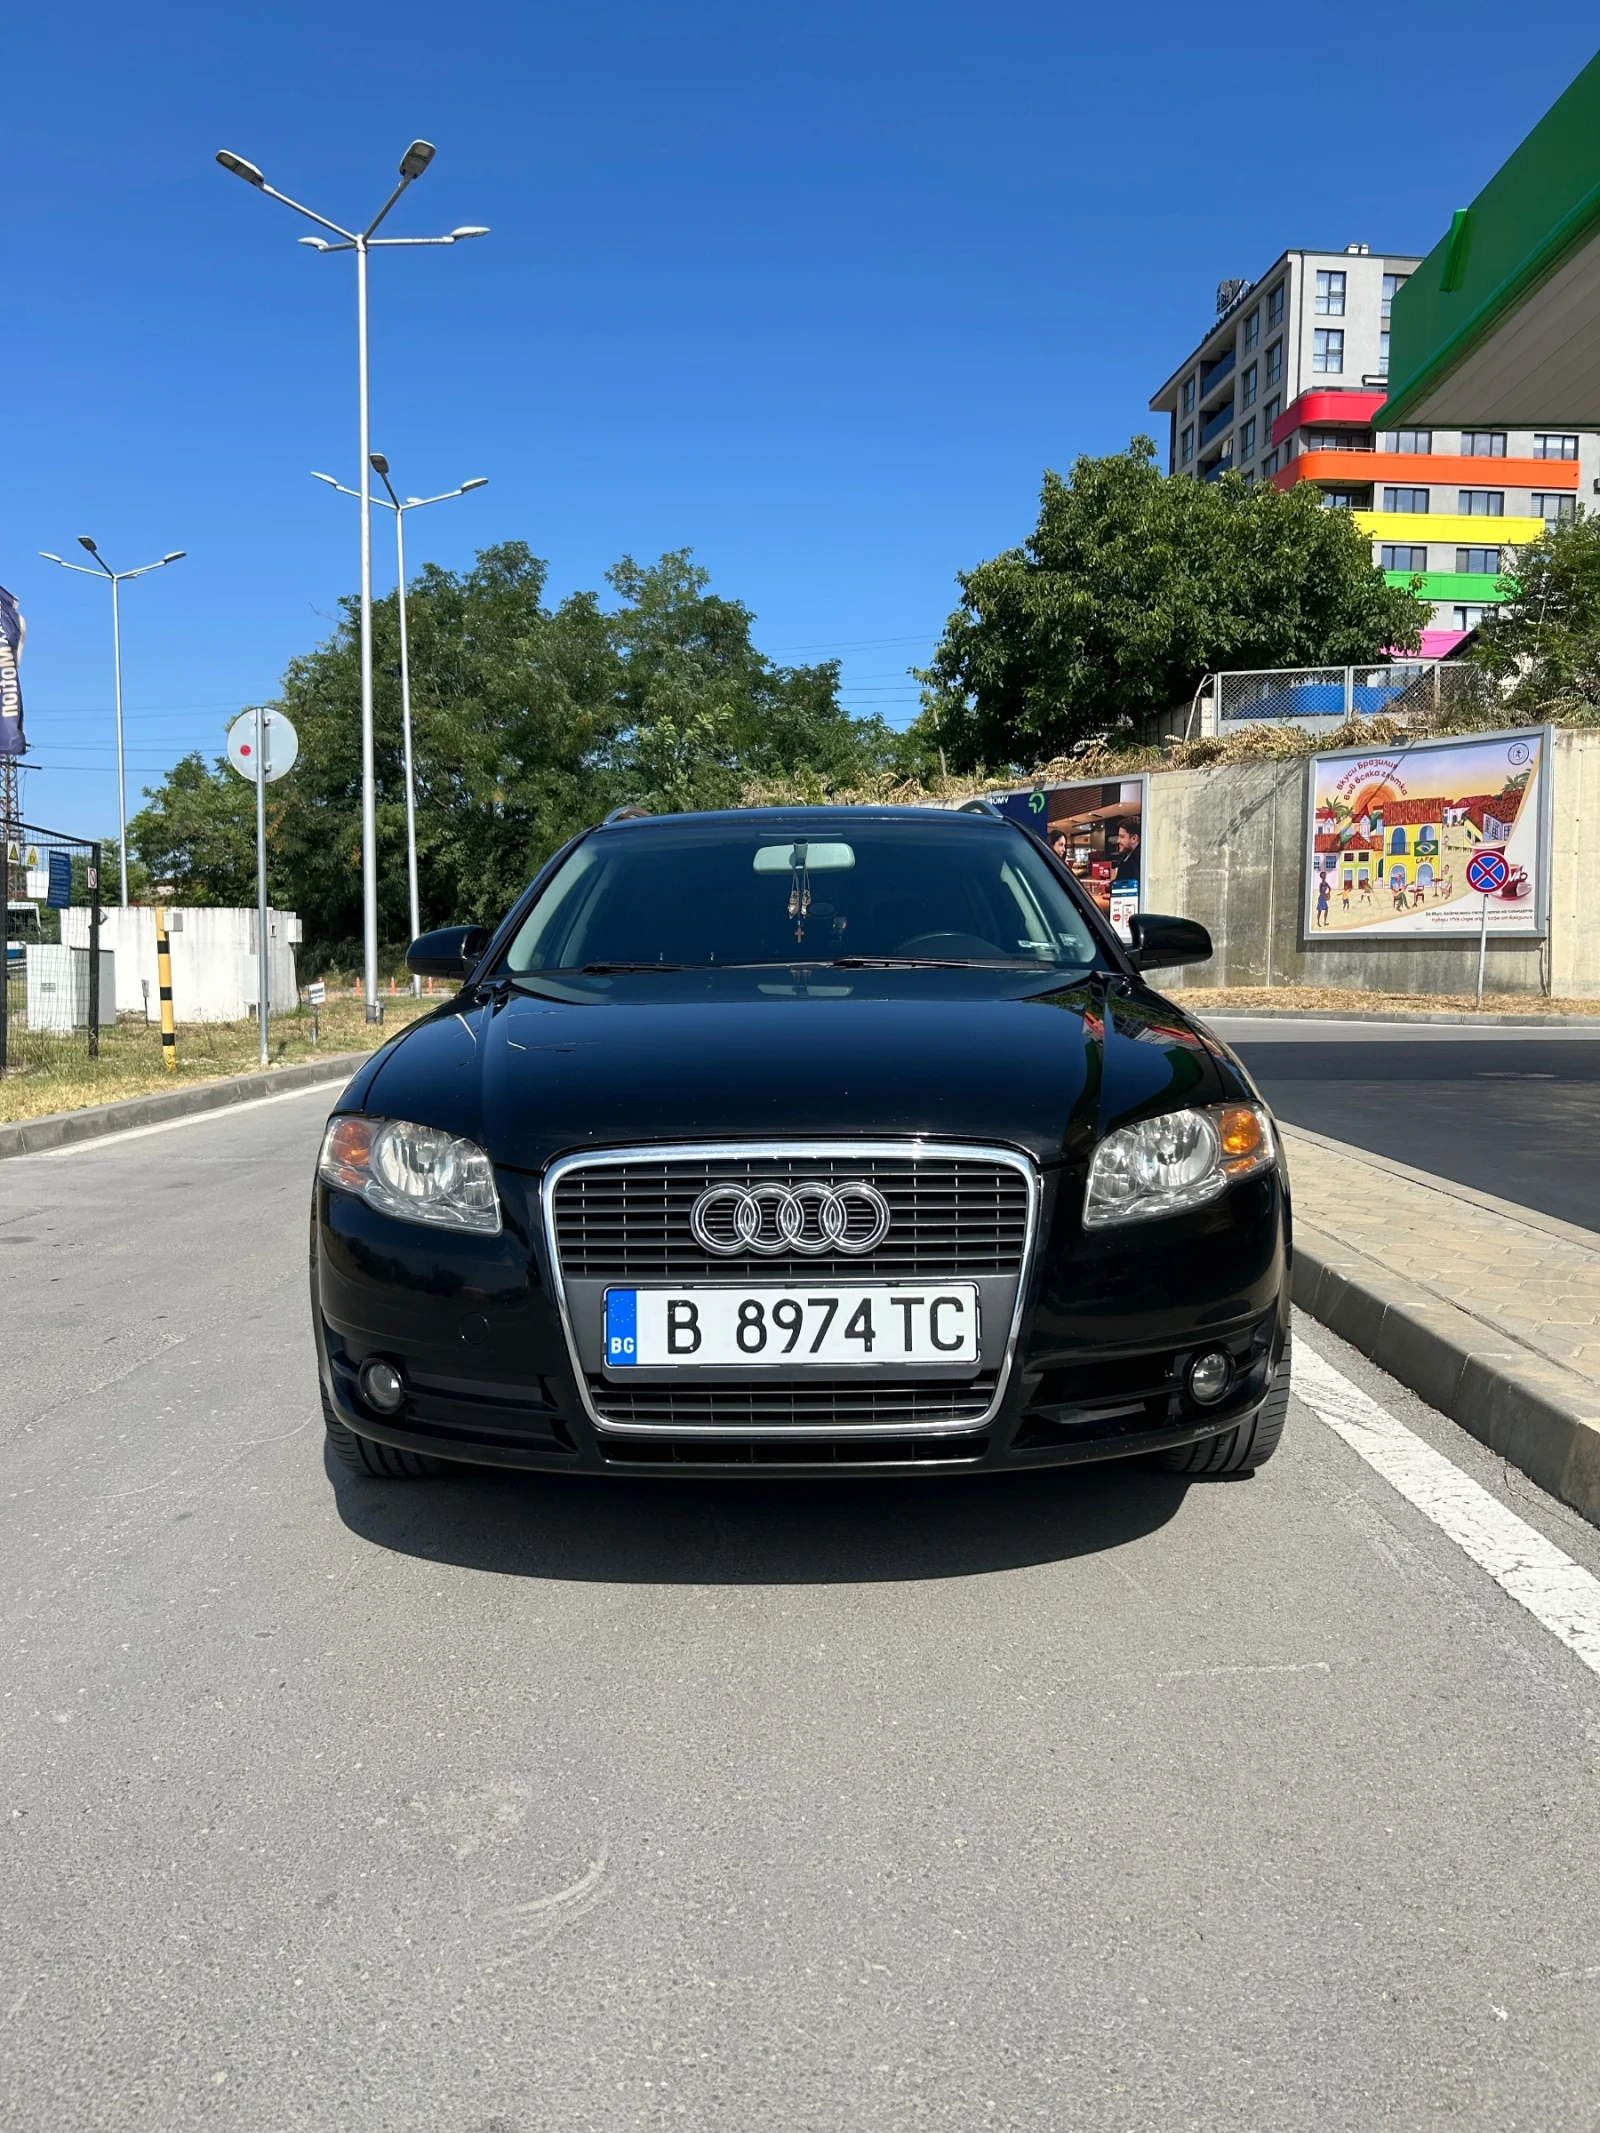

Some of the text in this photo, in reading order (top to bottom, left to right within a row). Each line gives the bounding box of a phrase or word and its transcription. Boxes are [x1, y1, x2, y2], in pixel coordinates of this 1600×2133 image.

[1336, 767, 1358, 791] Вкуси
[1354, 769, 1380, 784] всяка
[992, 796, 1009, 805] OMV
[667, 1296, 965, 1354] B 8974 TC
[610, 1336, 635, 1354] BG
